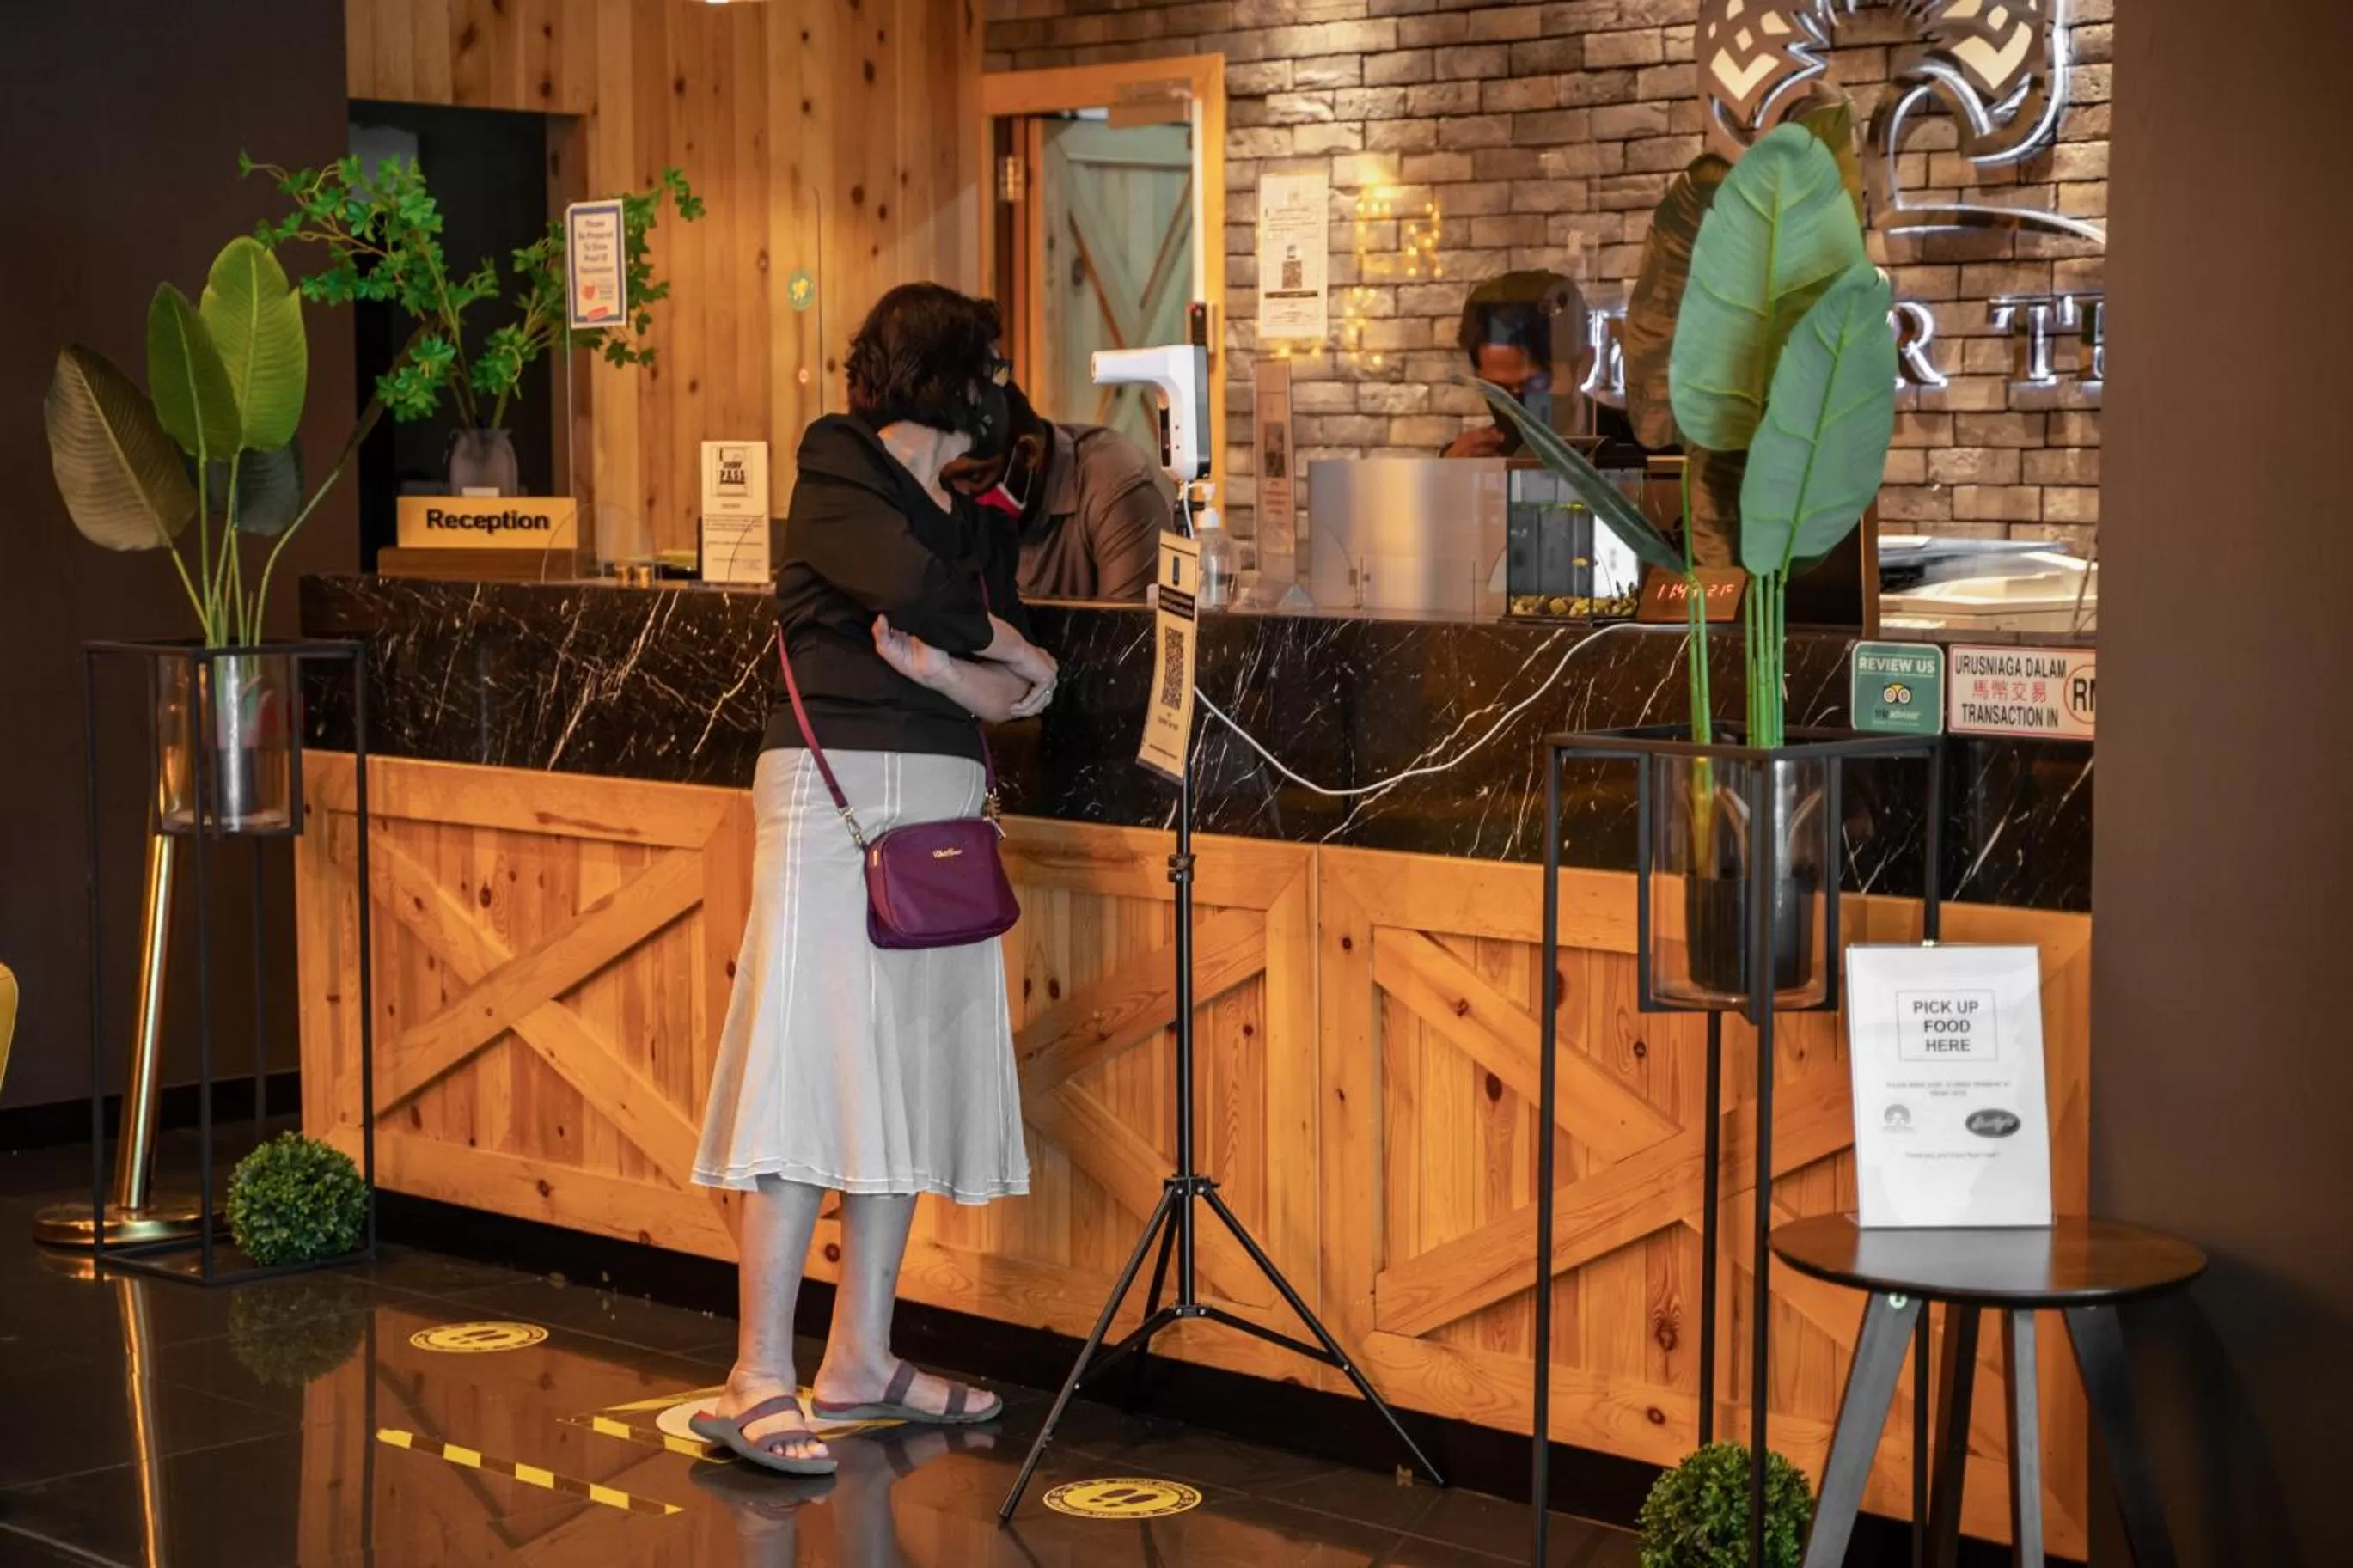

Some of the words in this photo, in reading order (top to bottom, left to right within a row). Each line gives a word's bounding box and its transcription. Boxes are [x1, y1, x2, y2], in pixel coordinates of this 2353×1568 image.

[426, 509, 550, 534] Reception
[1859, 656, 1912, 672] REVIEW
[1916, 660, 1935, 674] US
[1955, 655, 2022, 676] URUSNIAGA
[2026, 657, 2067, 678] DALAM
[1961, 703, 2043, 726] TRANSACTION
[2046, 707, 2059, 728] IN
[1913, 1000, 1952, 1014] PICK
[1957, 1000, 1979, 1014] UP
[1923, 1020, 1971, 1033] FOOD
[1925, 1039, 1971, 1052] HERE
